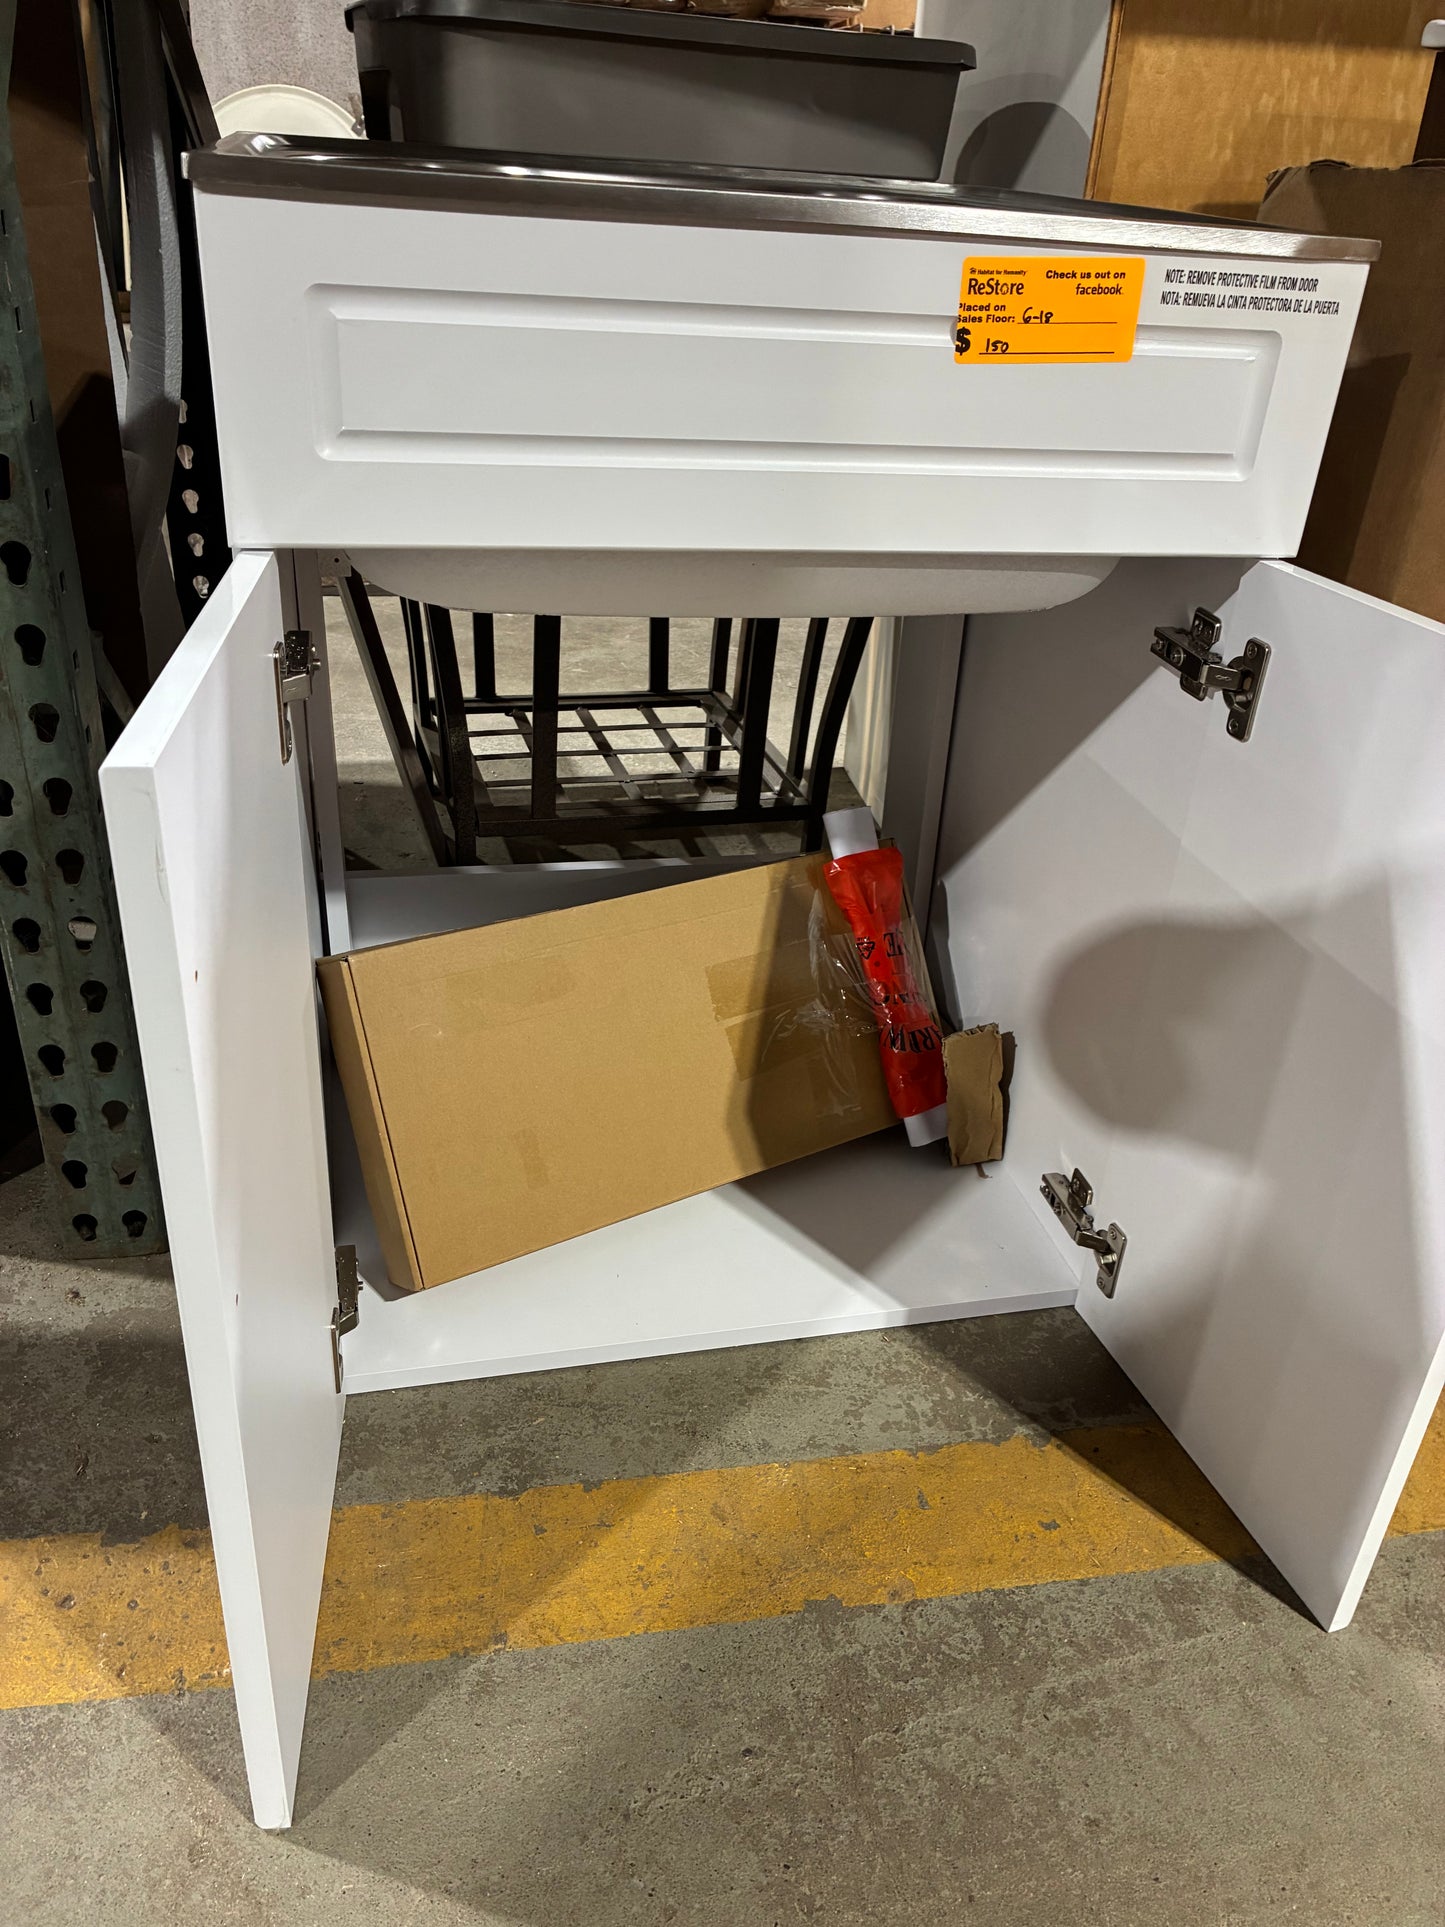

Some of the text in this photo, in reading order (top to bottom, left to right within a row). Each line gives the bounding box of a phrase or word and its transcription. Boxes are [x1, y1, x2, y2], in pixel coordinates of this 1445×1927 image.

[1045, 269, 1077, 279] Check
[1094, 270, 1111, 279] out
[1164, 268, 1319, 292] NOTE: REMOVE PROTECTIVE FILM FROM DOOR
[967, 277, 1025, 295] ReStore
[1075, 283, 1123, 295] facebook
[993, 304, 1006, 312] on
[1160, 290, 1340, 315] NOTA: REMUEVA LA CINTA PROTECTORA DE LA PUERTA
[985, 314, 1015, 323] Floor:
[1022, 306, 1054, 324] 6-18
[955, 326, 1009, 356] $ 150
